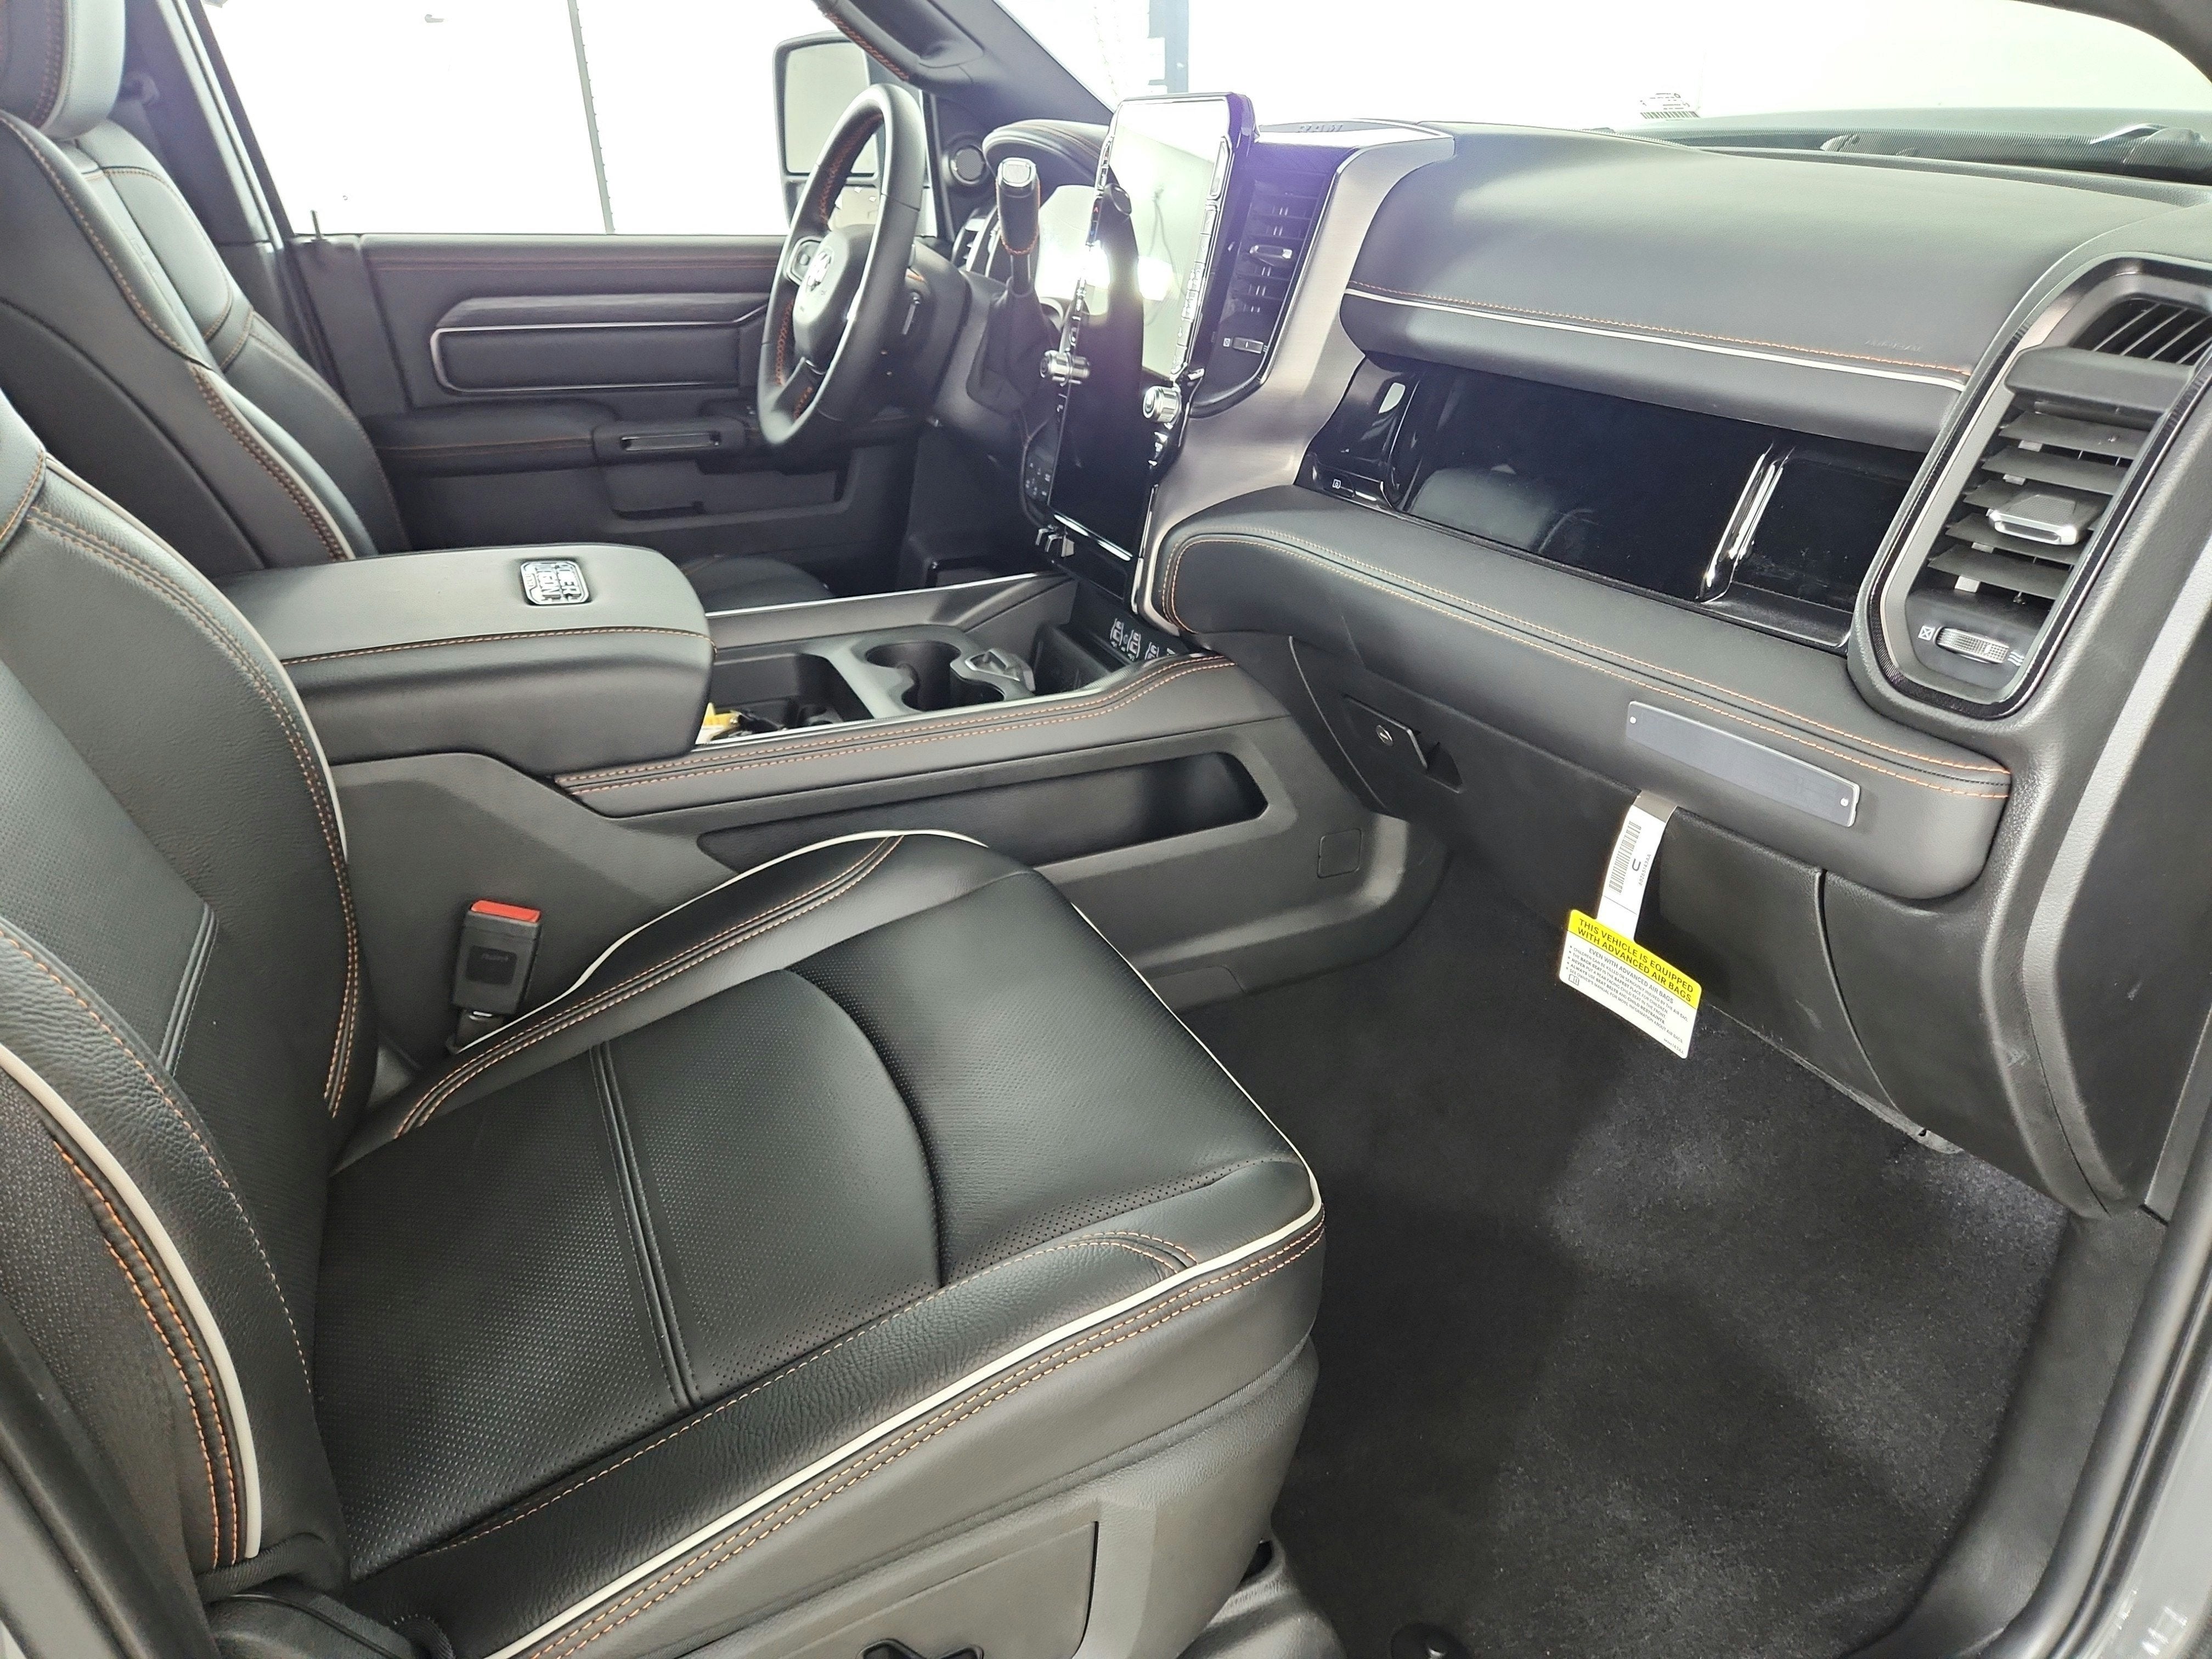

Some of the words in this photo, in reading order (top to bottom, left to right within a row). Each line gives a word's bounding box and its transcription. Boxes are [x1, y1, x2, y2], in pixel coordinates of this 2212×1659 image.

[1577, 926, 1600, 945] WITH
[1601, 940, 1650, 974] ADVANCED
[1651, 970, 1667, 985] AIR
[1668, 981, 1691, 1002] BAGS
[1578, 917, 1599, 935] THIS
[1600, 930, 1638, 957] VEHICLE
[1639, 952, 1648, 964] IS
[1650, 959, 1694, 994] EQUIPPED
[1589, 947, 1603, 960] EVEN
[1603, 956, 1618, 969] WITH
[1618, 964, 1648, 987] ADVANCED
[1648, 983, 1658, 994] AIR
[1658, 990, 1674, 1004] BAGS
